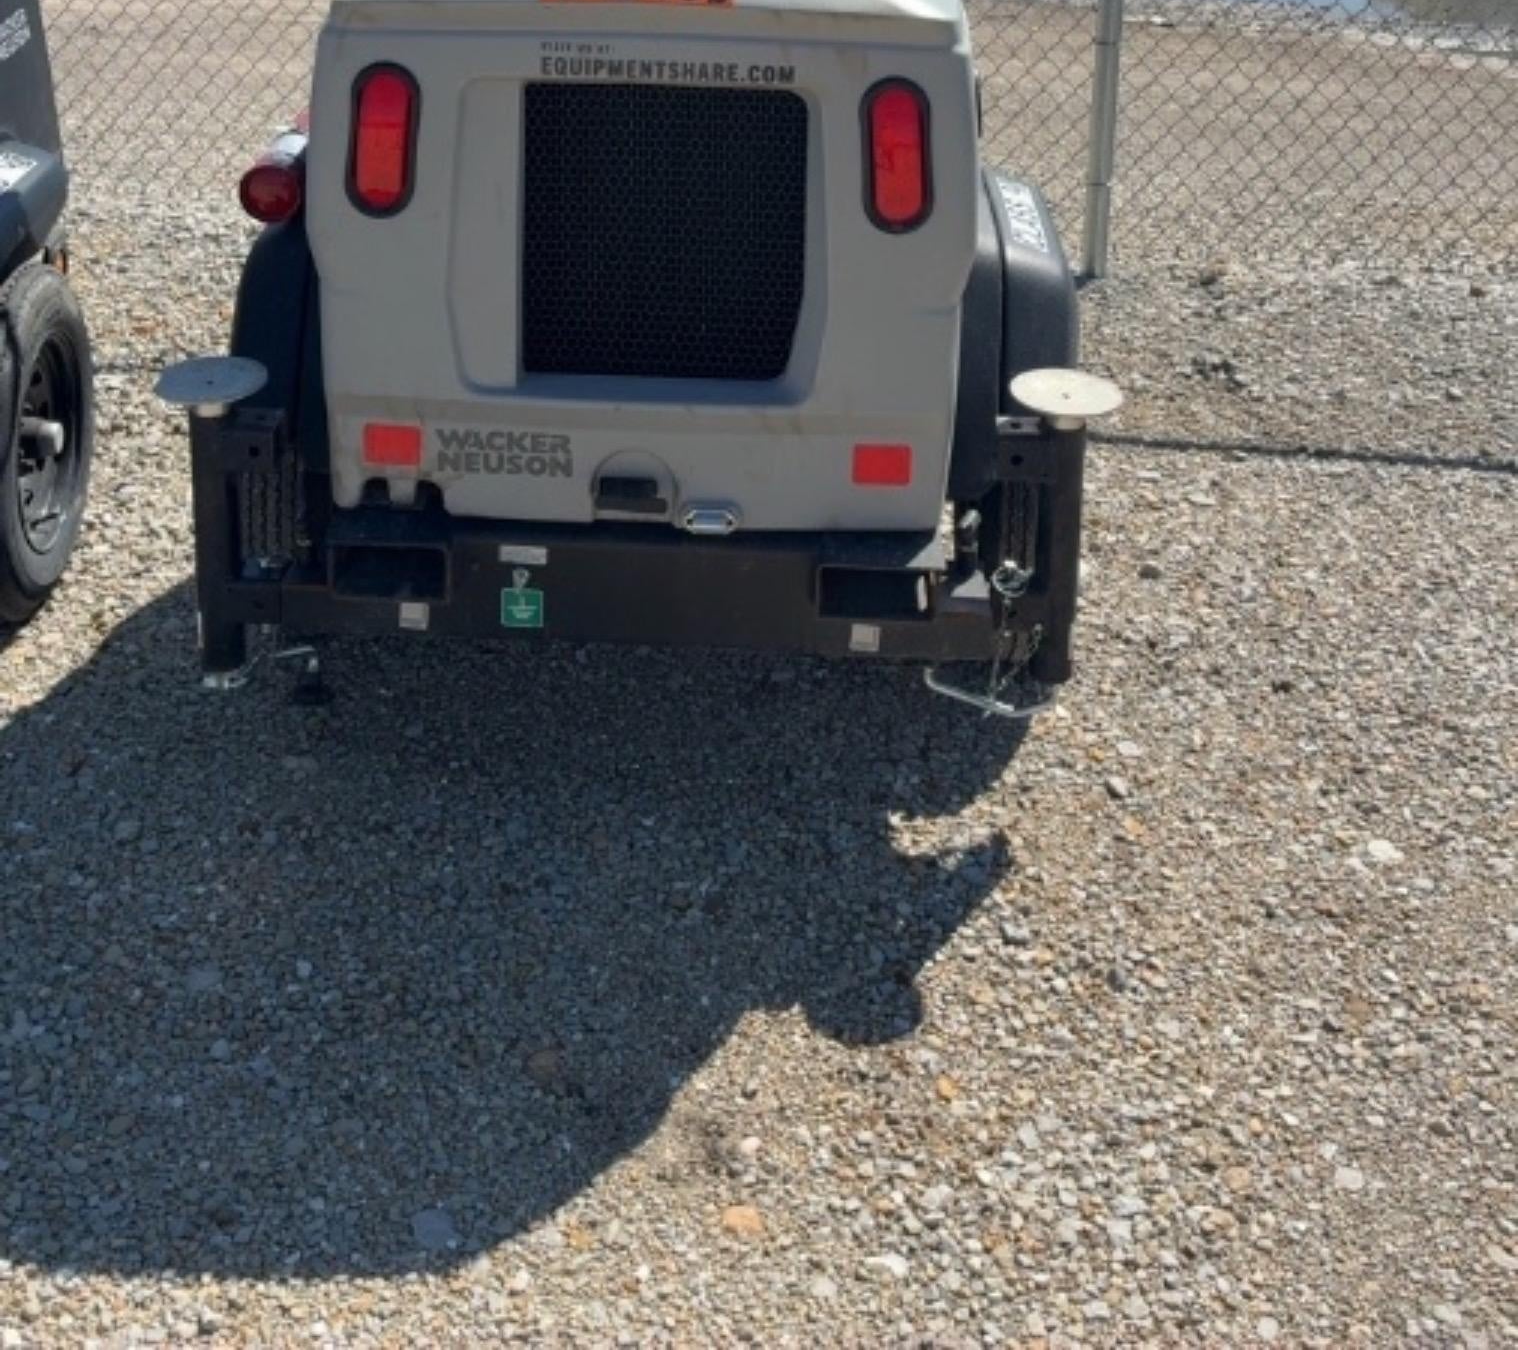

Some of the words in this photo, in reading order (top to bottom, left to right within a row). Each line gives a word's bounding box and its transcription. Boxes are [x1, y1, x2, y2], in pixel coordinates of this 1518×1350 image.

[541, 56, 796, 83] EQUIPMENTSHARE.COM
[435, 428, 573, 454] WACKER
[437, 450, 574, 478] NEUSON
